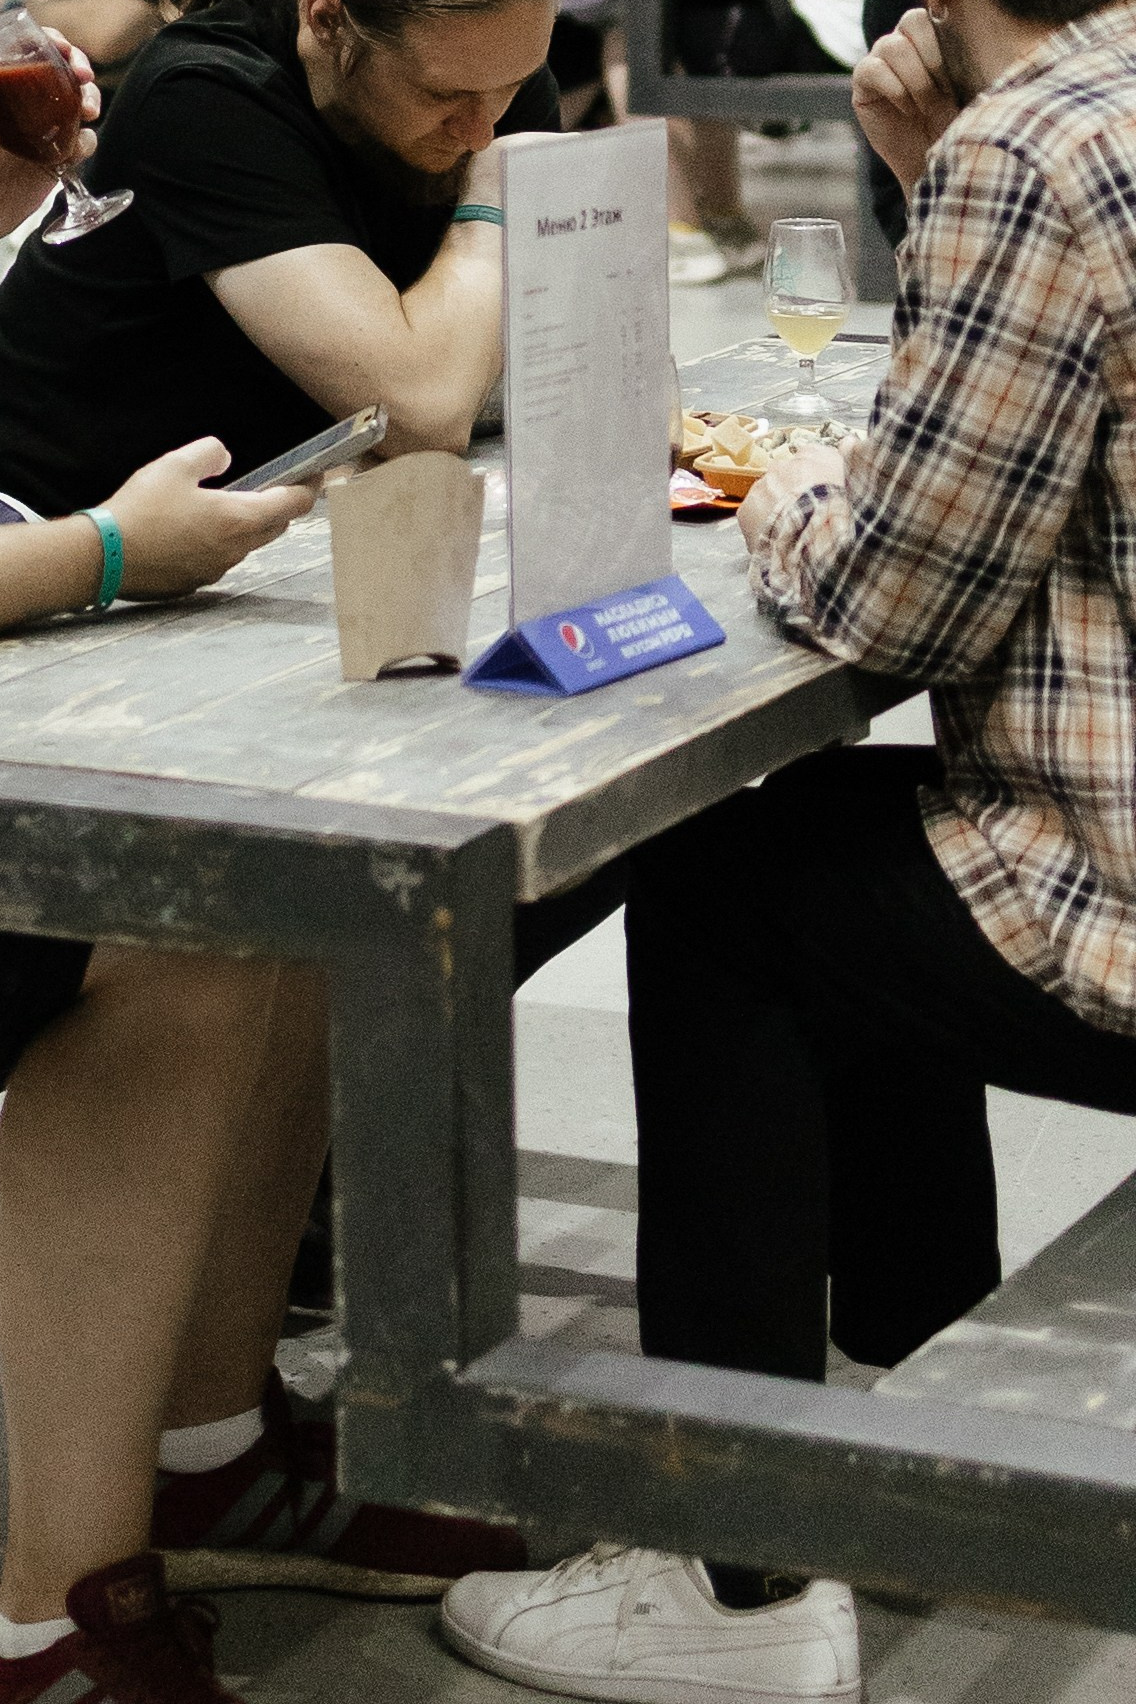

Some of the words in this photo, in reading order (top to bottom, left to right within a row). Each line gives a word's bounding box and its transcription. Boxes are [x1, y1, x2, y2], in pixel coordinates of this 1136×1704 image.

[536, 216, 577, 237] Меню
[578, 209, 588, 231] 2
[590, 206, 624, 229] Этаж
